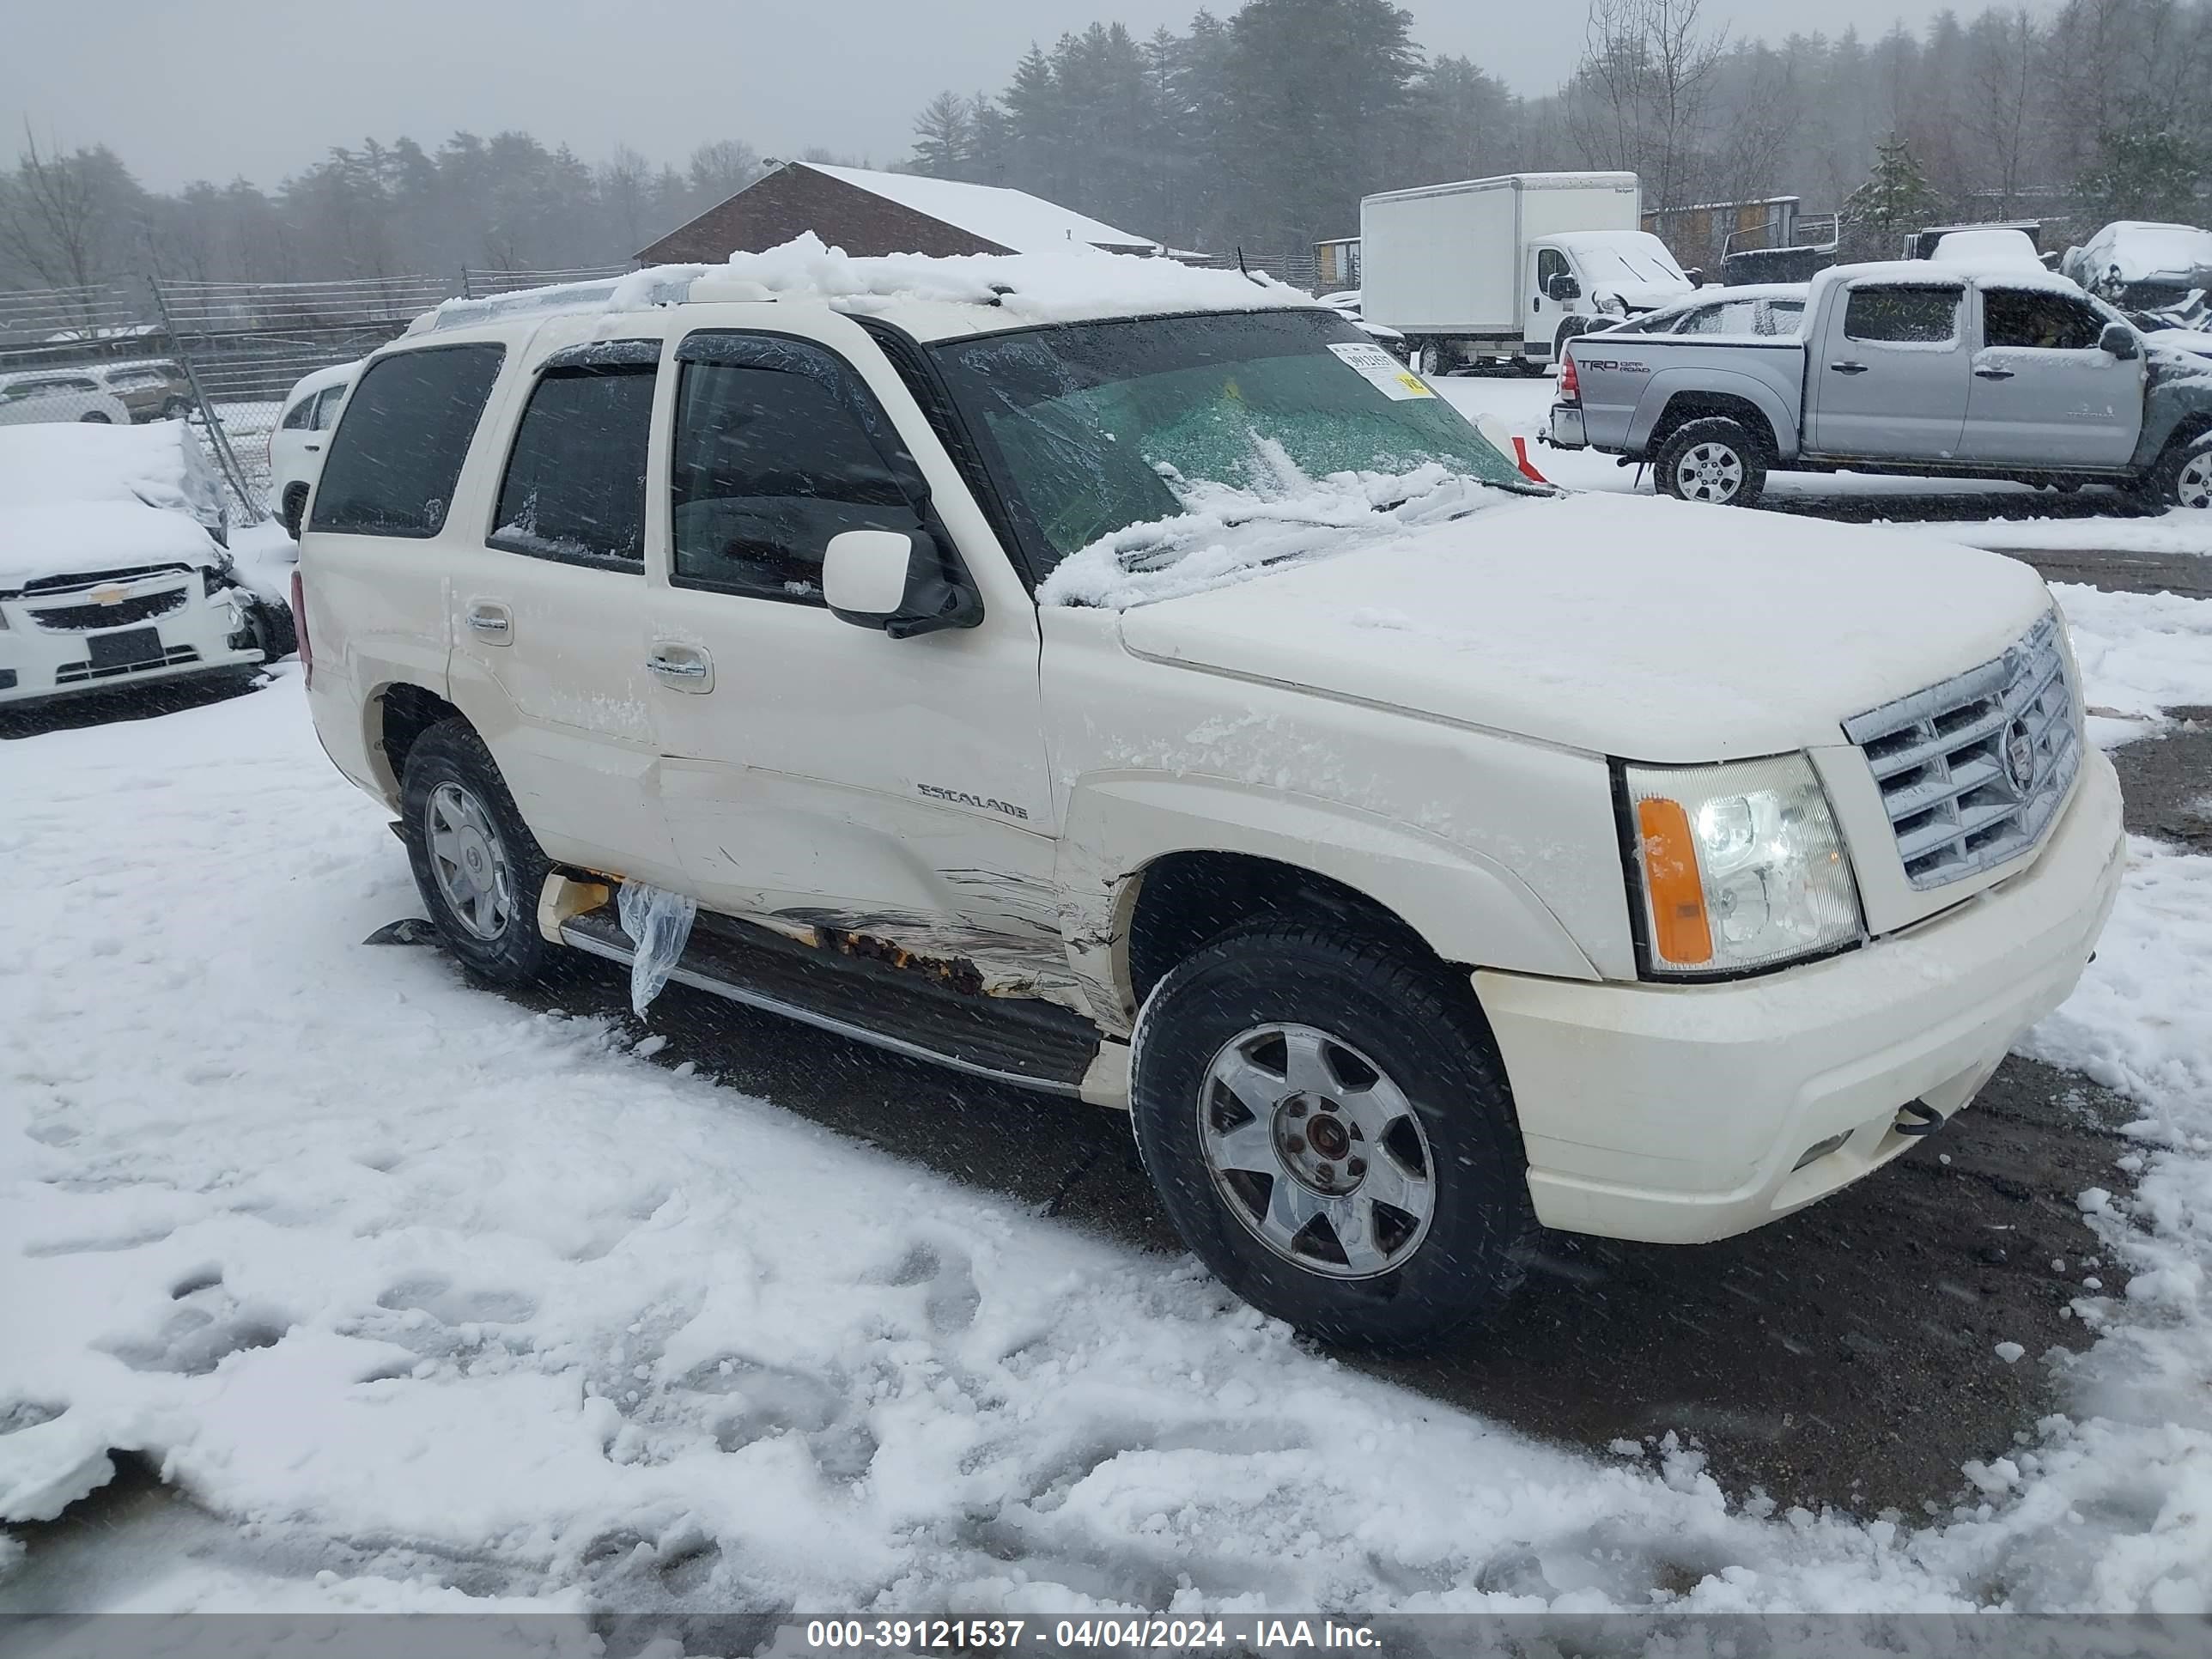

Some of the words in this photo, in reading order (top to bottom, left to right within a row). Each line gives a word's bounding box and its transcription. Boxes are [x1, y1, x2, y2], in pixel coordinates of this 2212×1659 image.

[1346, 355, 1395, 368] 39121537
[1577, 360, 1619, 372] TRD
[916, 782, 1029, 820] ESCALADE
